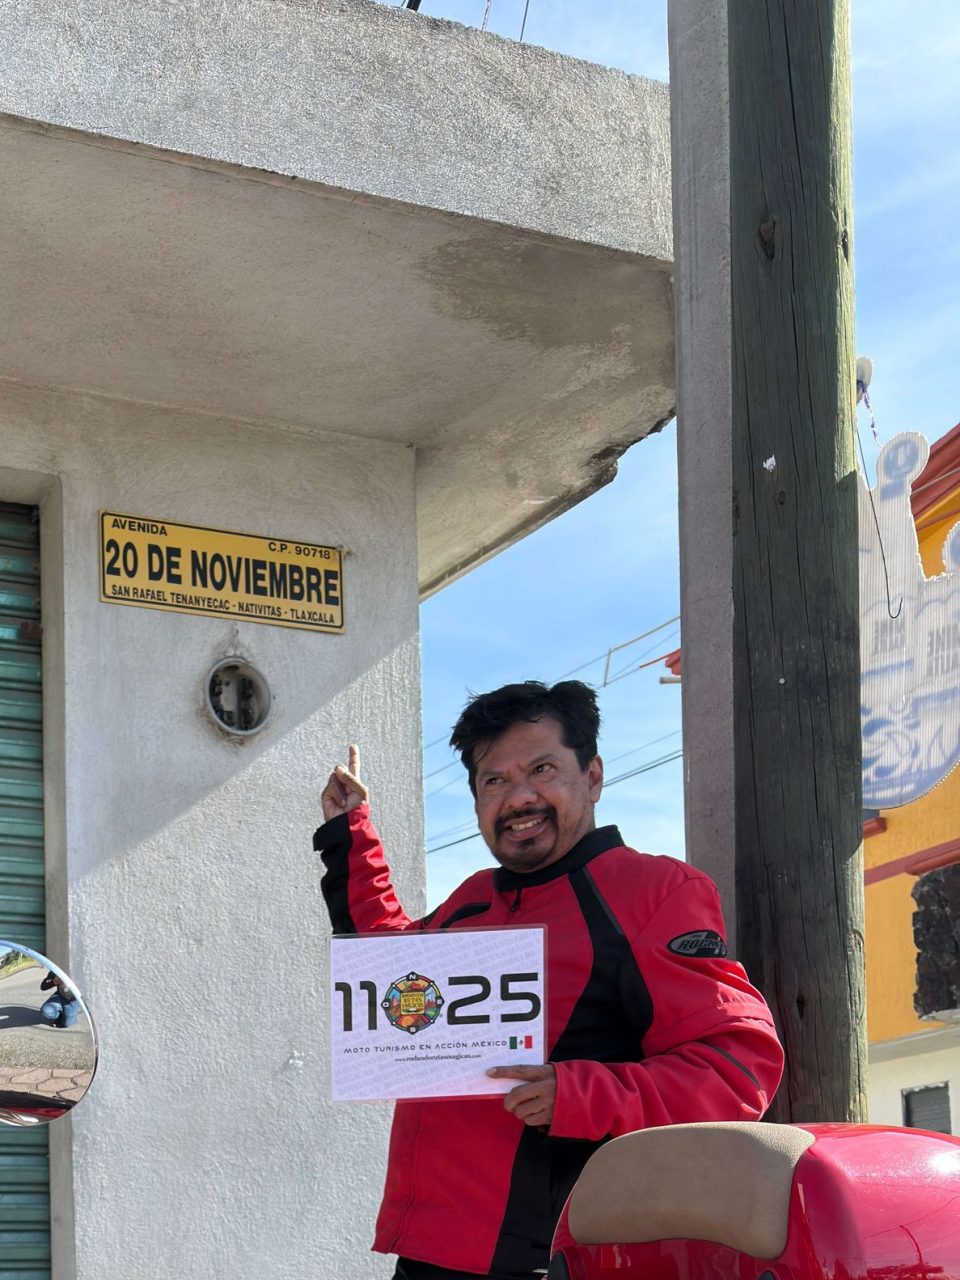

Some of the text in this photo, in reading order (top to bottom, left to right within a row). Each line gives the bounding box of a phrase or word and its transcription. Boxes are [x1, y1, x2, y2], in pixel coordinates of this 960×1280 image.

[111, 518, 168, 537] AVENIDA
[268, 541, 331, 560] C.P. 90718
[105, 538, 340, 607] 20 DE NOVIEMBRE
[111, 584, 130, 598] SAN
[132, 586, 167, 602] RAFAEL
[169, 592, 230, 611] TENANYECAC
[238, 601, 282, 618] NATIVITAS
[290, 608, 335, 625] TLAXCALA
[374, 1044, 416, 1053] TURISMO
